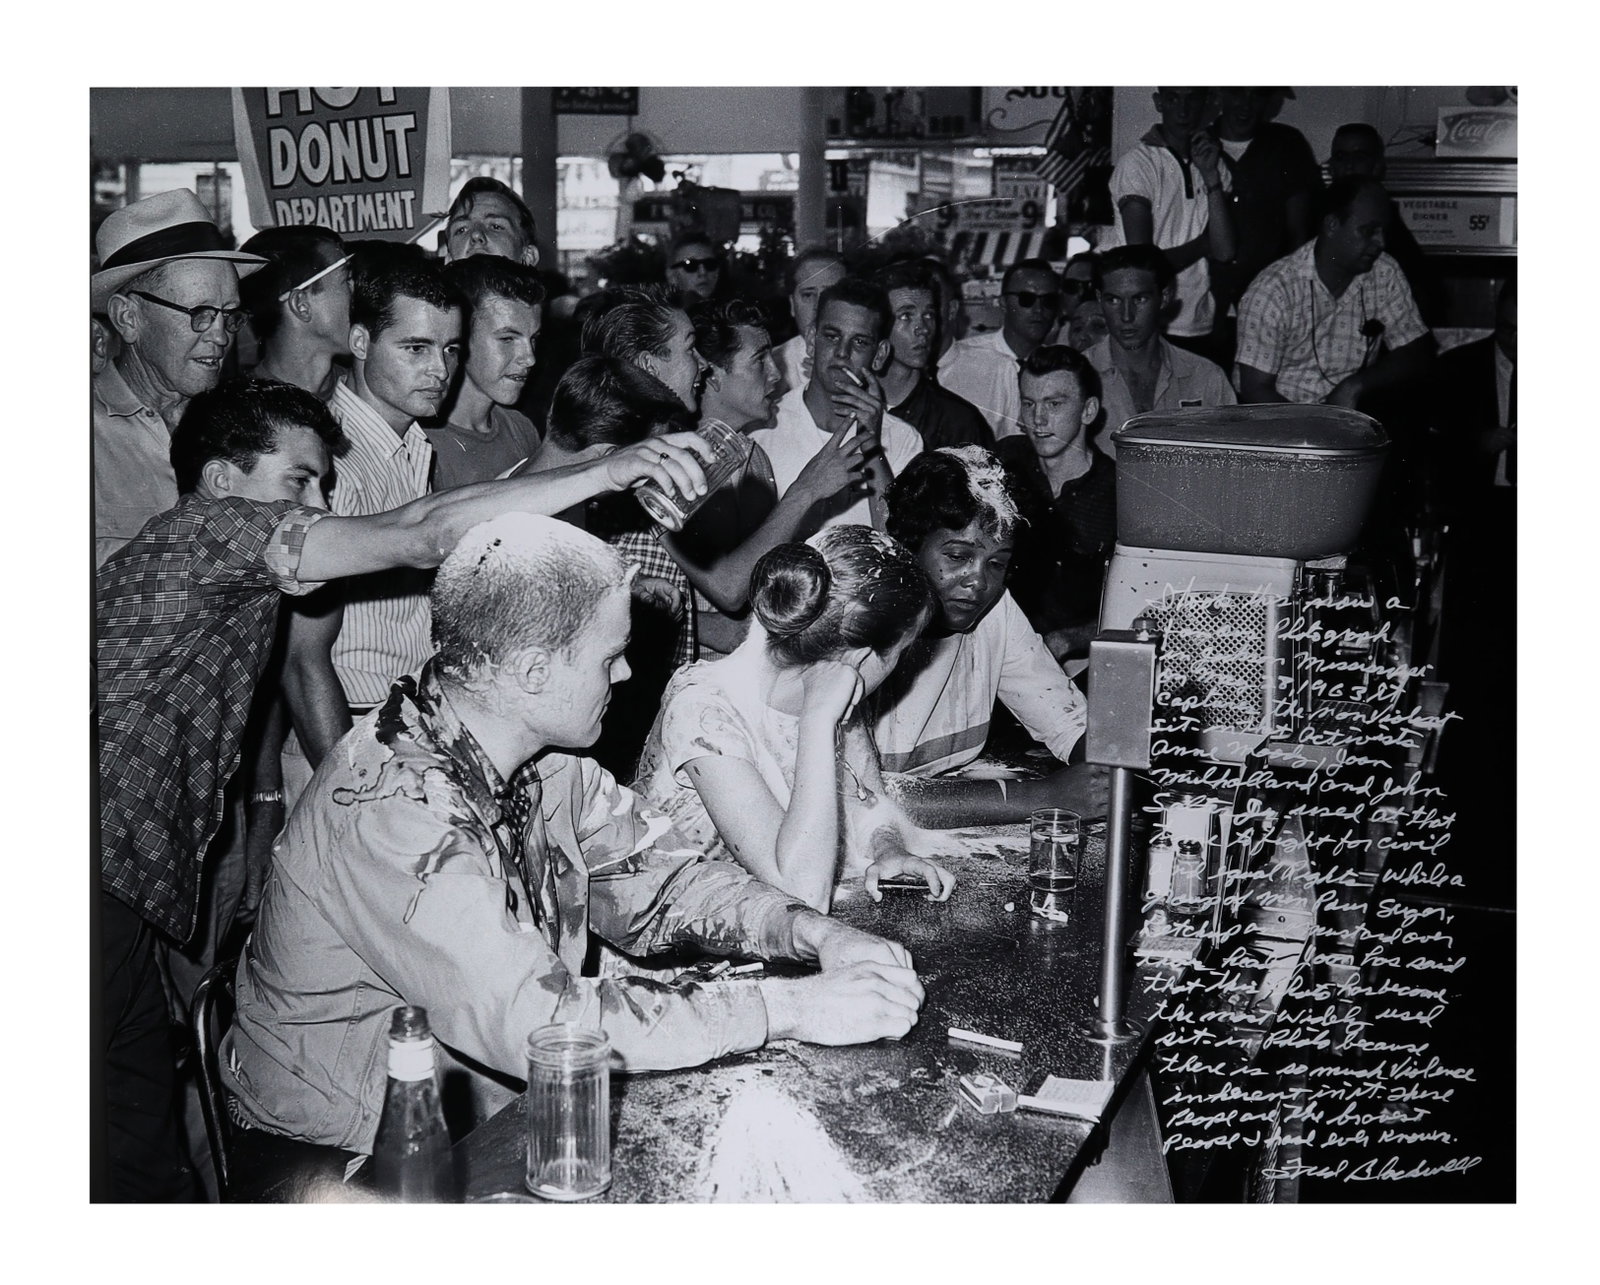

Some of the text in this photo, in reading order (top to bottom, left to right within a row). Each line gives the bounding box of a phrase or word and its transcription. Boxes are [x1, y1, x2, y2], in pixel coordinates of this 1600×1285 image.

[269, 113, 417, 187] DONUT
[274, 191, 416, 233] DEPARTMENT
[1303, 592, 1374, 612] now
[1386, 595, 1410, 609] a
[1298, 652, 1434, 682] Mississippi
[1271, 697, 1303, 719] the
[1326, 749, 1392, 776] Joan
[1151, 766, 1448, 804] Mulholland and John
[1371, 808, 1408, 825] at
[1250, 826, 1336, 855] fight
[1333, 829, 1373, 856] for
[1378, 831, 1450, 855] civil
[1450, 874, 1466, 886] a
[1223, 890, 1254, 913] of
[1256, 892, 1308, 908] men
[1403, 932, 1453, 948] over
[1293, 944, 1354, 980] Joan
[1362, 948, 1400, 966] has
[1406, 957, 1466, 973] said
[1338, 974, 1382, 997] has
[1378, 978, 1449, 1004] become
[1148, 1000, 1195, 1022] the
[1201, 1008, 1276, 1025] most
[1335, 1031, 1429, 1056] because
[1159, 1053, 1226, 1074] there
[1230, 1057, 1269, 1076] is
[1276, 1061, 1308, 1075] so
[1309, 1061, 1388, 1080] much
[1262, 1157, 1348, 1179] Fred
